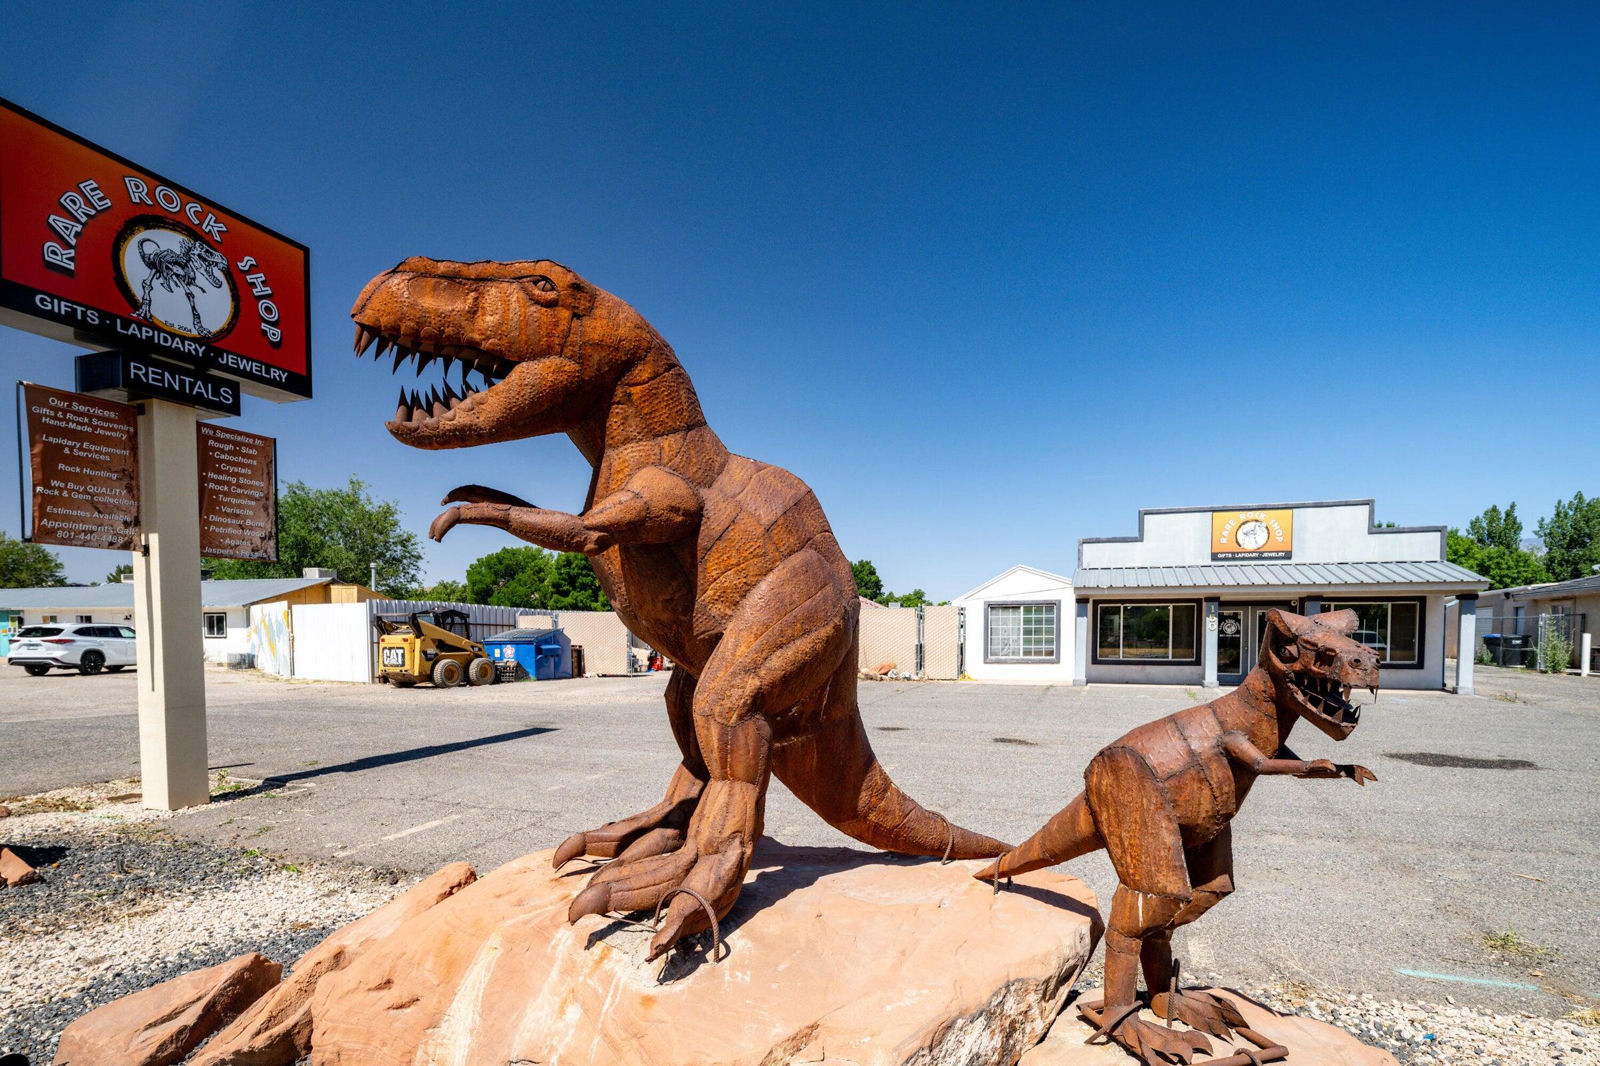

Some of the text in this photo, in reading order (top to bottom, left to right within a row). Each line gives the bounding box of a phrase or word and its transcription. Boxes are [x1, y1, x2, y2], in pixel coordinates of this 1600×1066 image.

[43, 177, 282, 342] RARE ROCK SHOP
[34, 294, 289, 383] GIFTS LAPIDARY JEWELRY
[130, 361, 234, 405] RENTALS
[48, 397, 118, 418] Our Services:
[32, 406, 54, 416] Gifts
[66, 413, 90, 424] Rock
[92, 418, 134, 432] Souvenirs
[42, 416, 128, 440] Hand-Made Jewelry
[201, 427, 264, 446] We Specialize In:
[42, 434, 129, 456] Lapidary Equipment
[208, 440, 258, 456] Rough Slab
[73, 448, 110, 461] Services
[214, 452, 257, 466] Cabochons
[58, 464, 118, 480] Rock Hunting
[220, 464, 252, 474] Crystals
[208, 472, 264, 487] Healing Stones
[36, 486, 60, 496] Rock
[62, 490, 68, 498] &
[72, 492, 91, 500] Gem
[50, 480, 127, 496] We Buy QUALITY
[208, 482, 264, 498] Rock Carvings
[218, 494, 256, 506] Turquoise
[46, 506, 131, 522] Estimates Available
[221, 506, 254, 516] Variscite
[40, 518, 114, 534] Appointments
[209, 514, 264, 528] Dinosaur Bone
[1220, 512, 1284, 544] RARE ROCK SHOP
[210, 526, 264, 538] Petrified Wood
[383, 649, 404, 665] CAT
